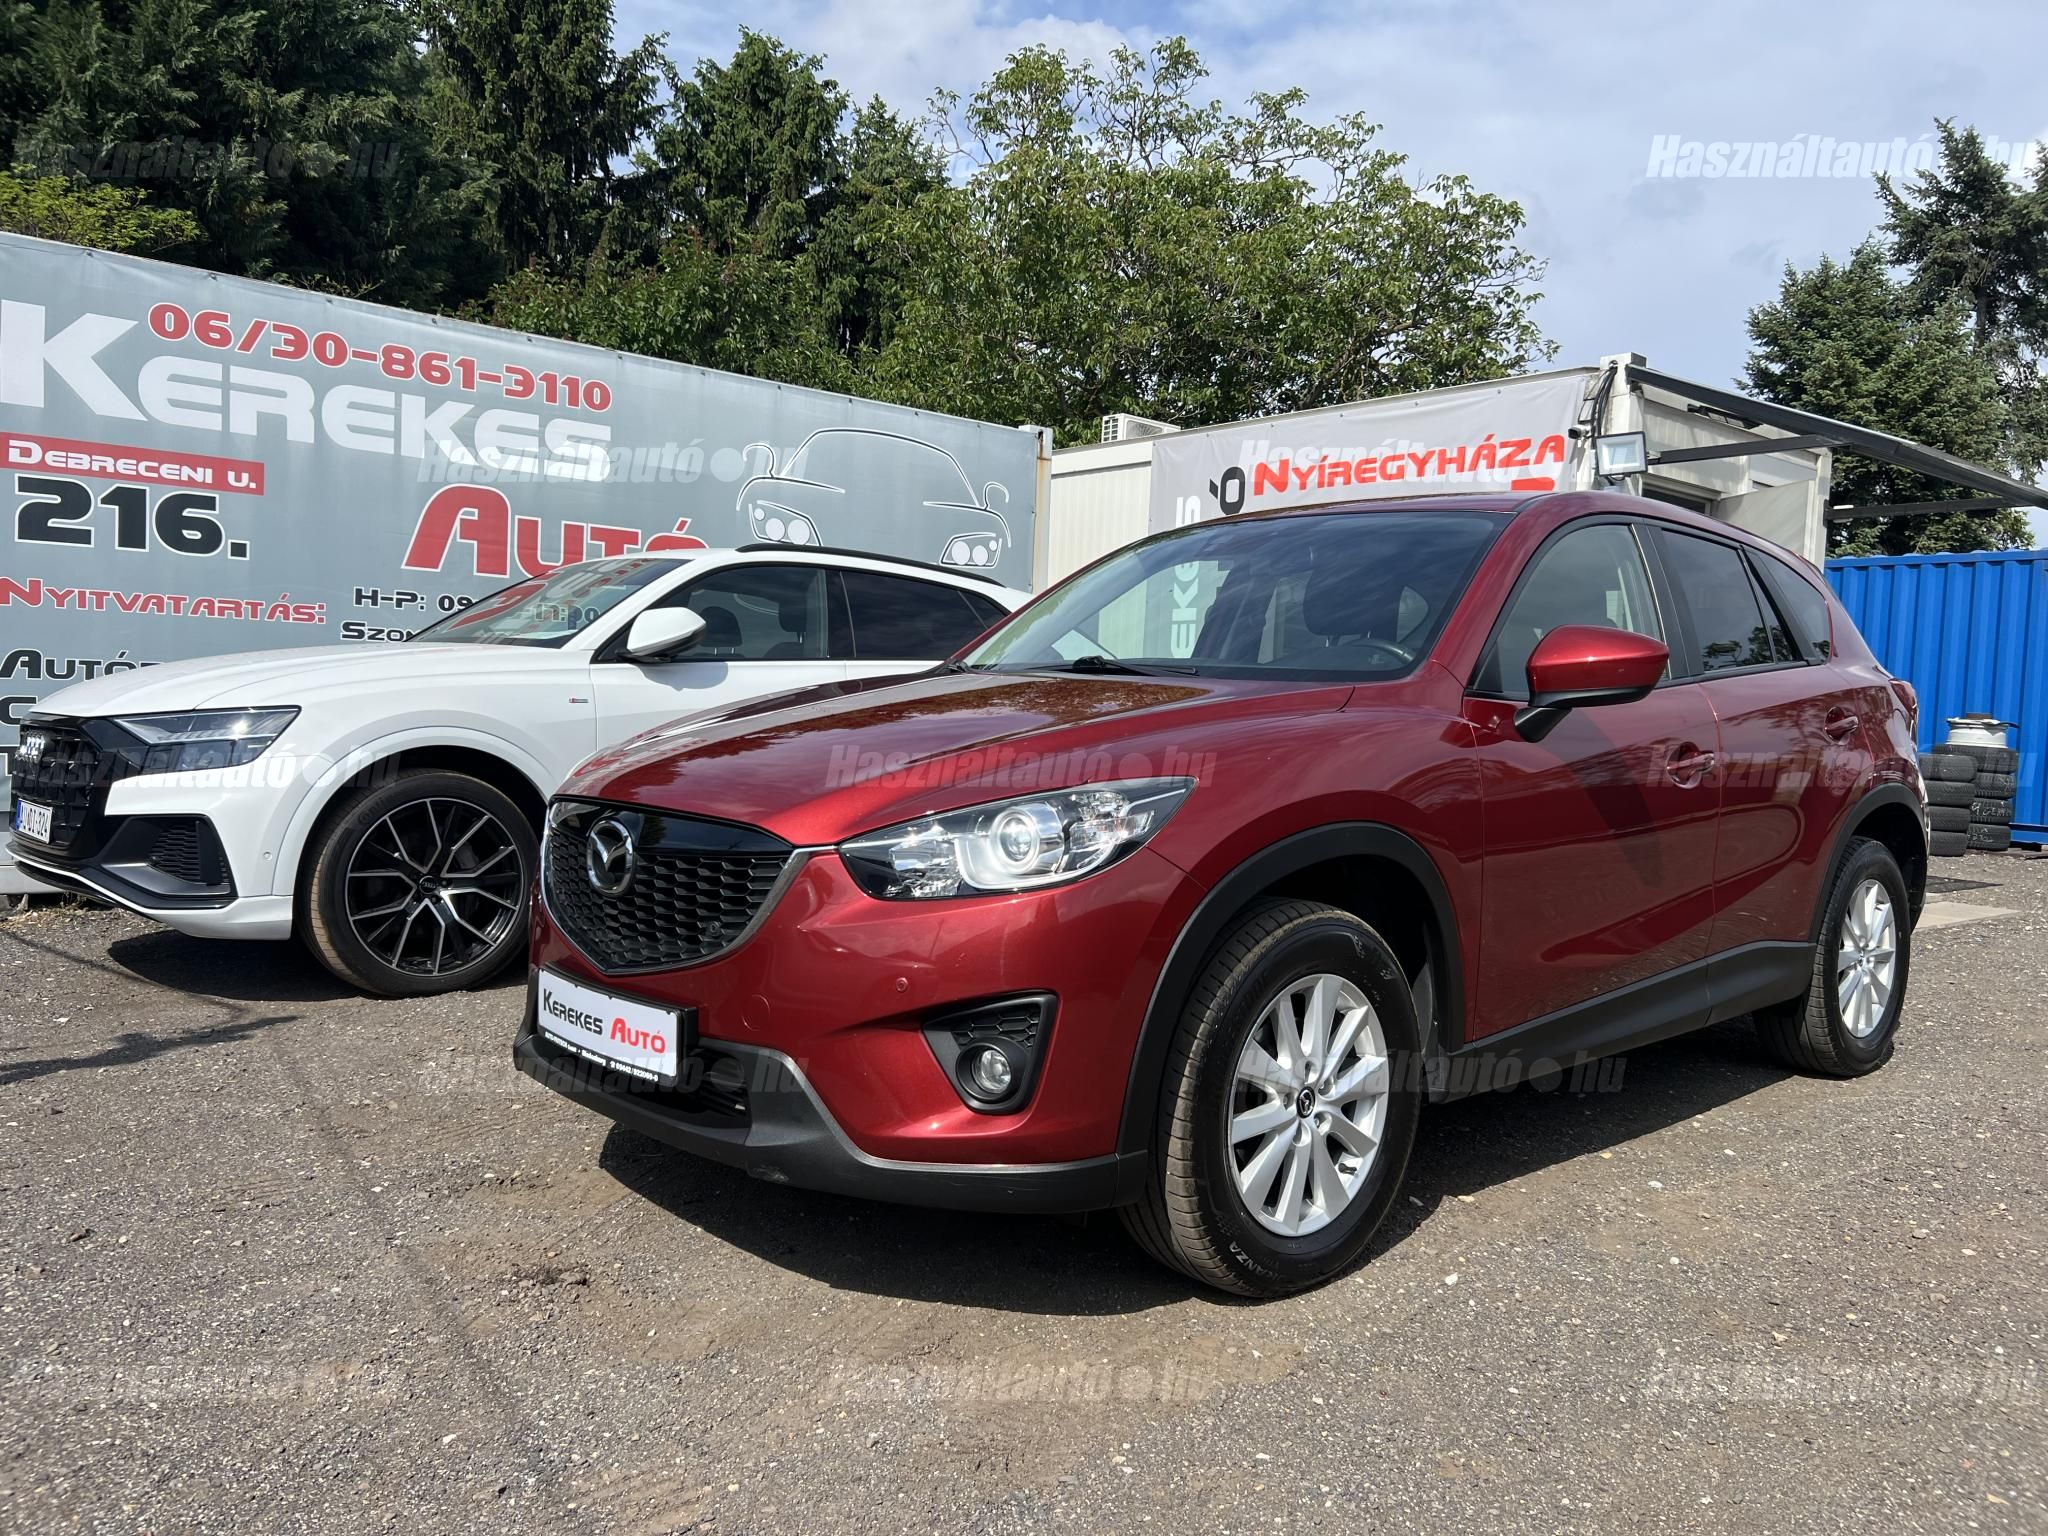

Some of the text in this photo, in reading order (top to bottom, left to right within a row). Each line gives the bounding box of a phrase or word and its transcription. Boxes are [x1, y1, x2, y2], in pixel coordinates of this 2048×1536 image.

[148, 303, 612, 411] 06/30-861-3110
[0, 300, 611, 481] KEREKES
[8, 439, 213, 483] DEBRECENI
[1253, 433, 1565, 496] NYÍREGYHÁZA
[15, 473, 250, 560] 216.
[0, 576, 326, 624] NYITVATARTÁS:
[353, 586, 426, 612] H-P:
[543, 988, 603, 1036] KEREKES
[610, 1017, 666, 1054] AUTÓ
